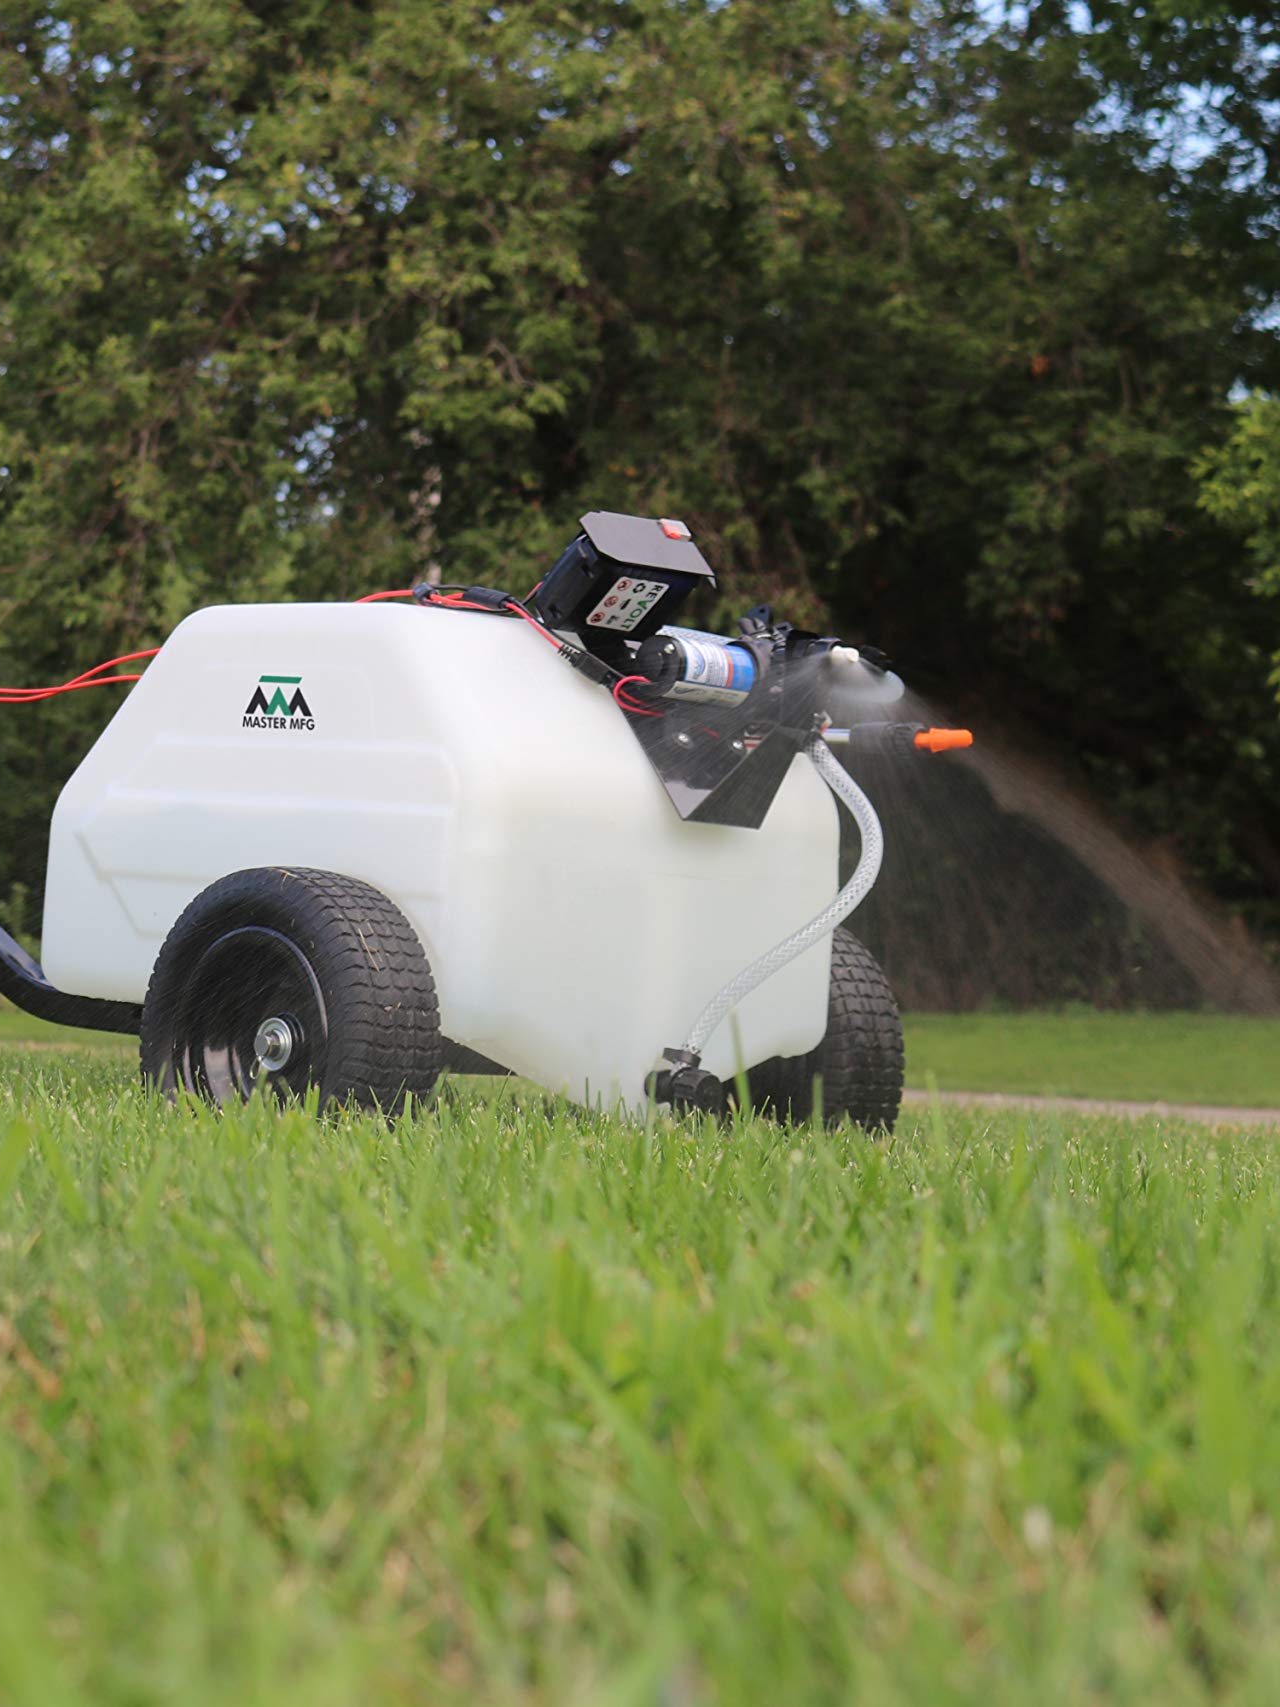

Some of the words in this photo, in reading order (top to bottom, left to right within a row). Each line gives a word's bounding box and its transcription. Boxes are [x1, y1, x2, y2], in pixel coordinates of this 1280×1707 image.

[621, 584, 664, 630] REVOLT
[242, 716, 287, 729] MASTER
[289, 718, 315, 731] MFG
